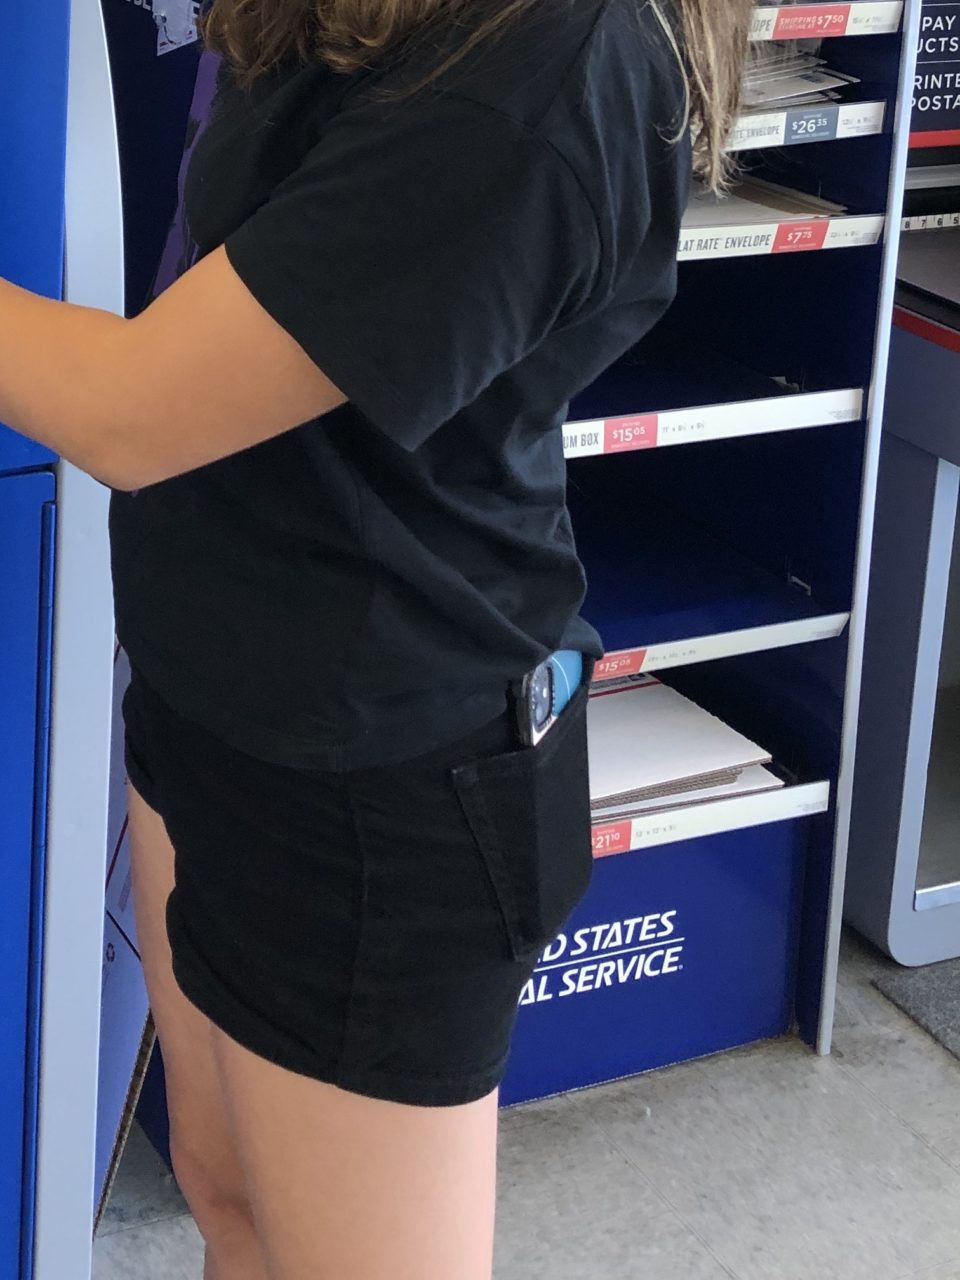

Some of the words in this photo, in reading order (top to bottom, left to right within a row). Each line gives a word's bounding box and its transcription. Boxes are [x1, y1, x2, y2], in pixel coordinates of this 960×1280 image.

[921, 15, 957, 32] PAY
[724, 233, 772, 249] ENVELOPE
[580, 432, 599, 447] BOX
[570, 909, 677, 957] STATES
[558, 946, 683, 997] SERVICE
